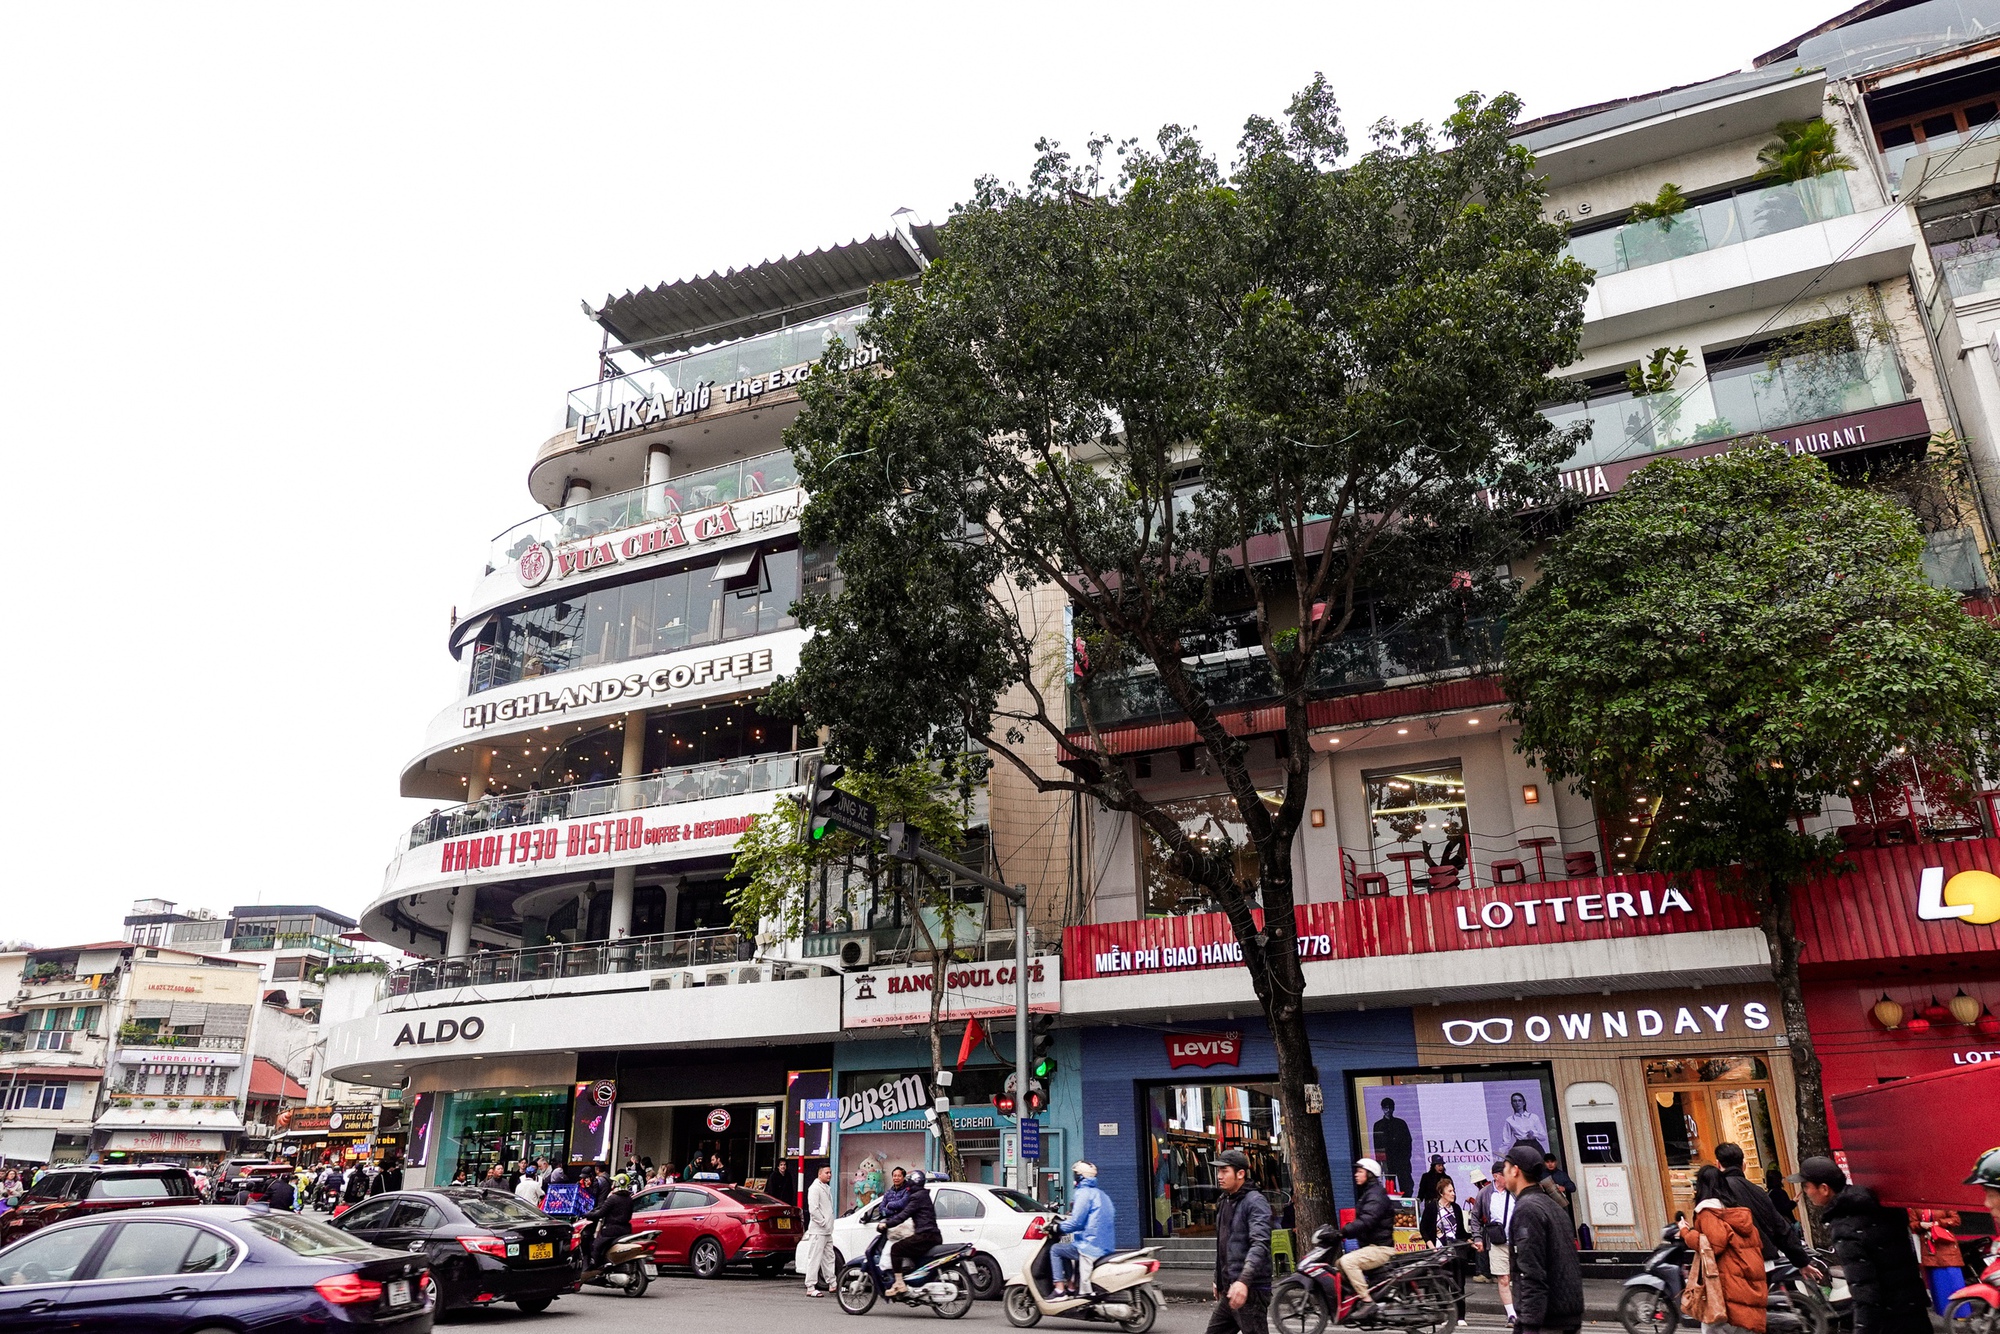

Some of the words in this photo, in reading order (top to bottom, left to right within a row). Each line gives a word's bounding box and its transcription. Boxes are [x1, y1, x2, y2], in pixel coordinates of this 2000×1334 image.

[576, 392, 667, 444] LAIKA
[672, 380, 715, 417] Café
[722, 377, 770, 404] The
[768, 344, 883, 391] Exction
[557, 541, 618, 578] VUA
[694, 503, 742, 541] CÁ
[463, 674, 643, 728] HIGHLANDS
[648, 648, 773, 693] COFFEE
[441, 834, 504, 873] HANOI
[508, 827, 558, 864] 1930
[566, 816, 643, 857] BISTRO
[643, 825, 681, 845] COFFEE
[682, 824, 691, 840] &
[693, 815, 756, 839] RESTAURAN
[1456, 887, 1693, 931] LOTTERIA
[1095, 945, 1131, 973] MIỄN
[1135, 945, 1159, 969] PHÍ
[1163, 946, 1197, 968] GIAO
[888, 974, 934, 994] HANO
[947, 968, 994, 989] SOUL
[393, 1016, 485, 1046] ALDO
[1524, 1002, 1771, 1042] OWNDAYS
[153, 1055, 209, 1063] HERBALIST
[881, 1119, 931, 1131] HOMEMADE
[961, 1116, 994, 1128] CREAM
[1427, 1139, 1489, 1153] BLACK
[1428, 1154, 1490, 1163] CLLECTION
[1595, 1177, 1609, 1188] 20
